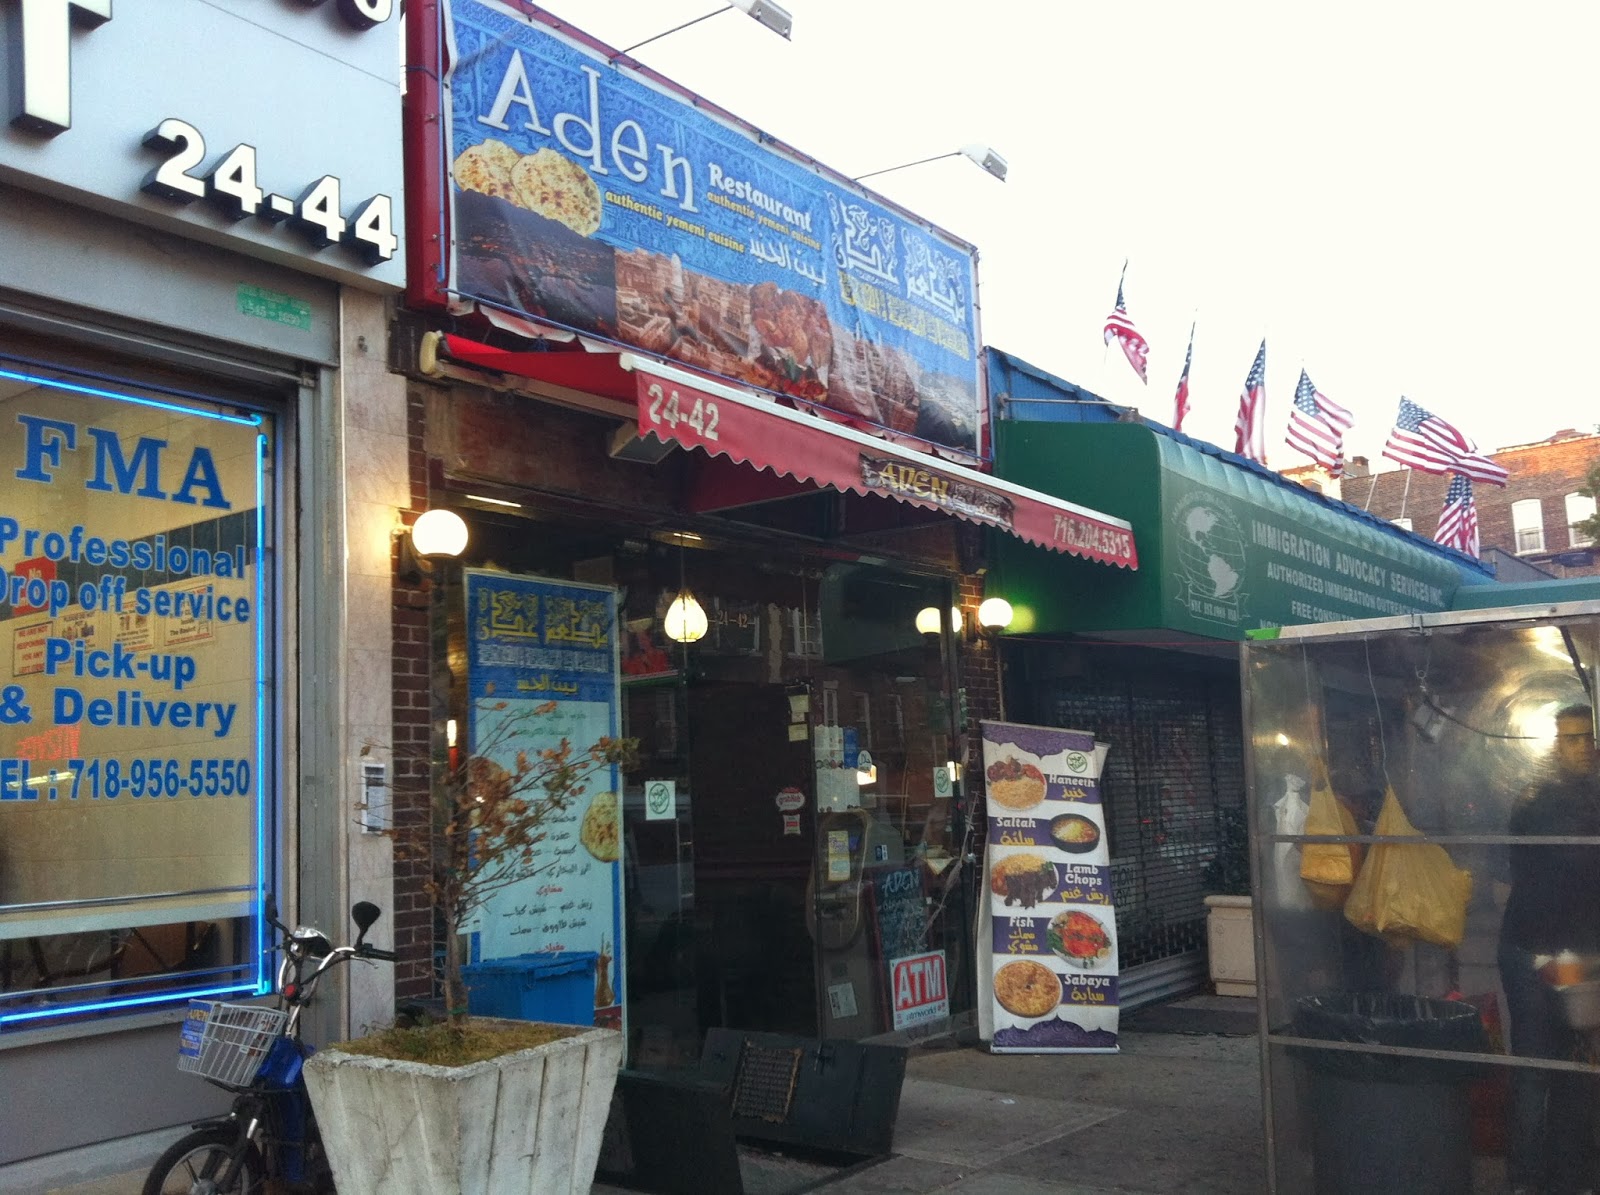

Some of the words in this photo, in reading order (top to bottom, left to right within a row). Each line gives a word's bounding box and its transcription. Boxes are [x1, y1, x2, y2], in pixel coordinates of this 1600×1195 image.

[477, 48, 698, 213] Aden
[150, 117, 398, 262] 24-44
[706, 191, 756, 219] authentic
[708, 162, 812, 233] Restaurant
[605, 190, 663, 221] authentic
[665, 213, 706, 238] yemeni
[707, 231, 746, 254] cuisine
[648, 383, 719, 442] 24-42
[16, 414, 232, 510] FMA
[0, 516, 246, 580] Professional
[1251, 519, 1331, 570] IMMIGRATION
[1336, 551, 1386, 589] ADVOCACY
[78, 574, 127, 613] off
[136, 586, 250, 622] service
[1267, 561, 1324, 594] AUTHORIZED
[1291, 600, 1312, 620] FREE
[44, 637, 196, 691] Pick-up
[0, 685, 33, 725] &
[53, 687, 237, 738] Delivery
[67, 758, 250, 800] 718-956-5550
[1049, 774, 1096, 788] Haneeth
[996, 817, 1037, 829] Saltah
[1064, 873, 1103, 888] Chops
[1066, 863, 1100, 875] Lamb
[1009, 917, 1035, 928] Fish
[894, 959, 943, 1009] ATM
[1064, 974, 1111, 987] Sabaya
